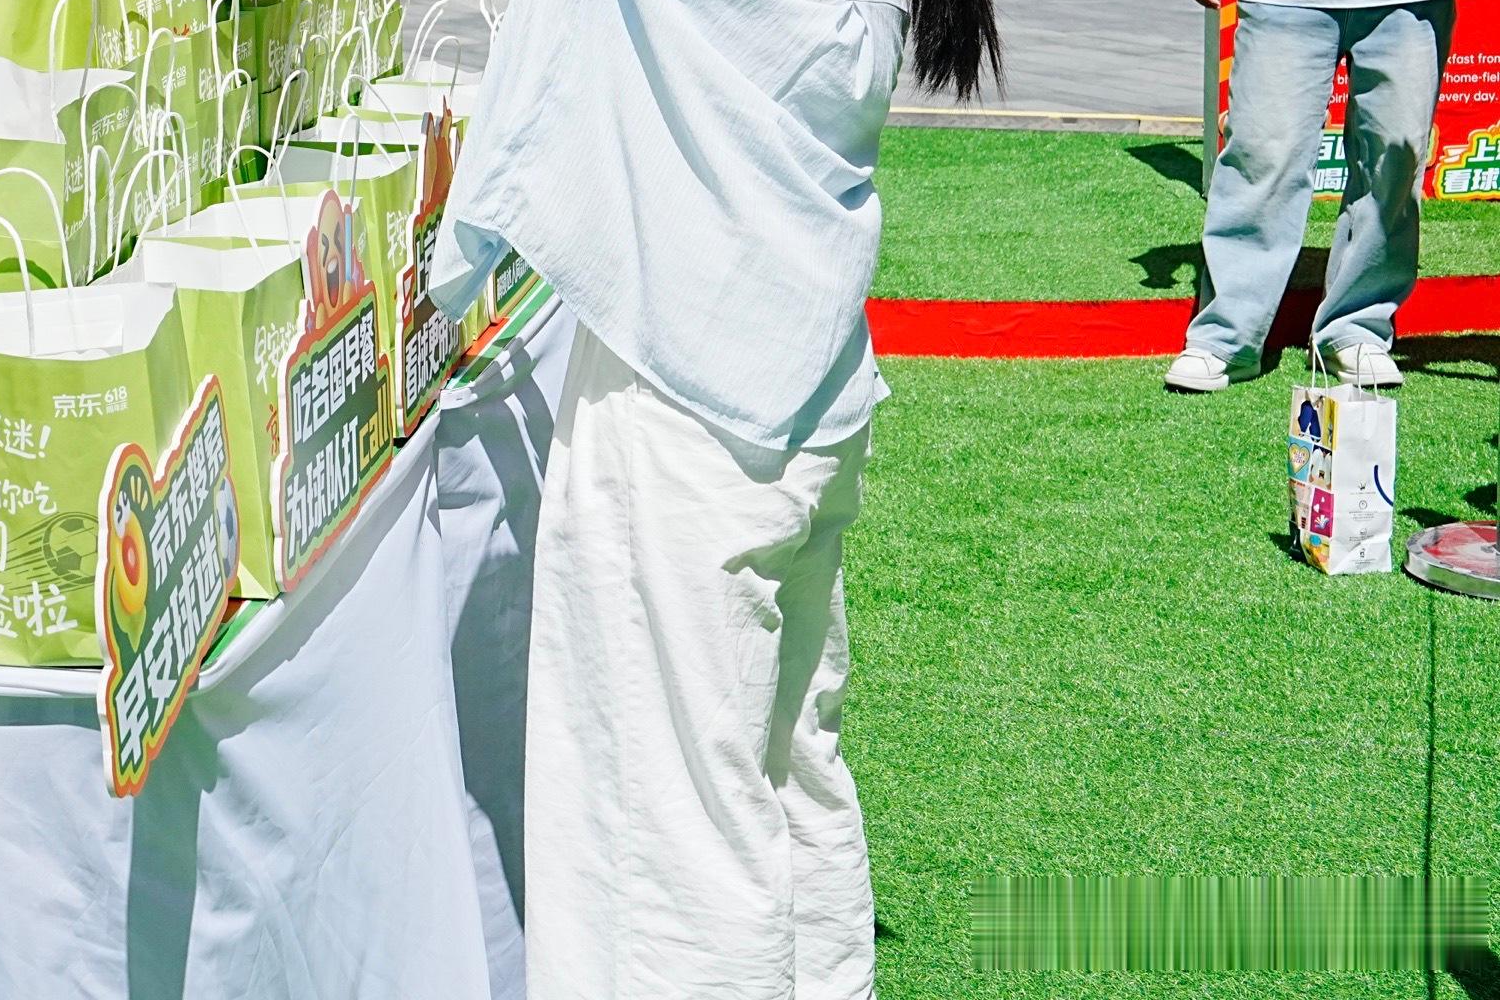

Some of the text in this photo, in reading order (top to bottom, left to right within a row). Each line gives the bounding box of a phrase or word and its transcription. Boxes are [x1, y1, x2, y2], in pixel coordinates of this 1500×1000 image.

[1438, 91, 1499, 104] every day.
[1443, 168, 1500, 193] 看球
[52, 385, 128, 418] 京东 618
[292, 308, 376, 444] 吃各国早餐
[149, 401, 225, 591] 京东搜索
[115, 514, 224, 767] 早安球迷
